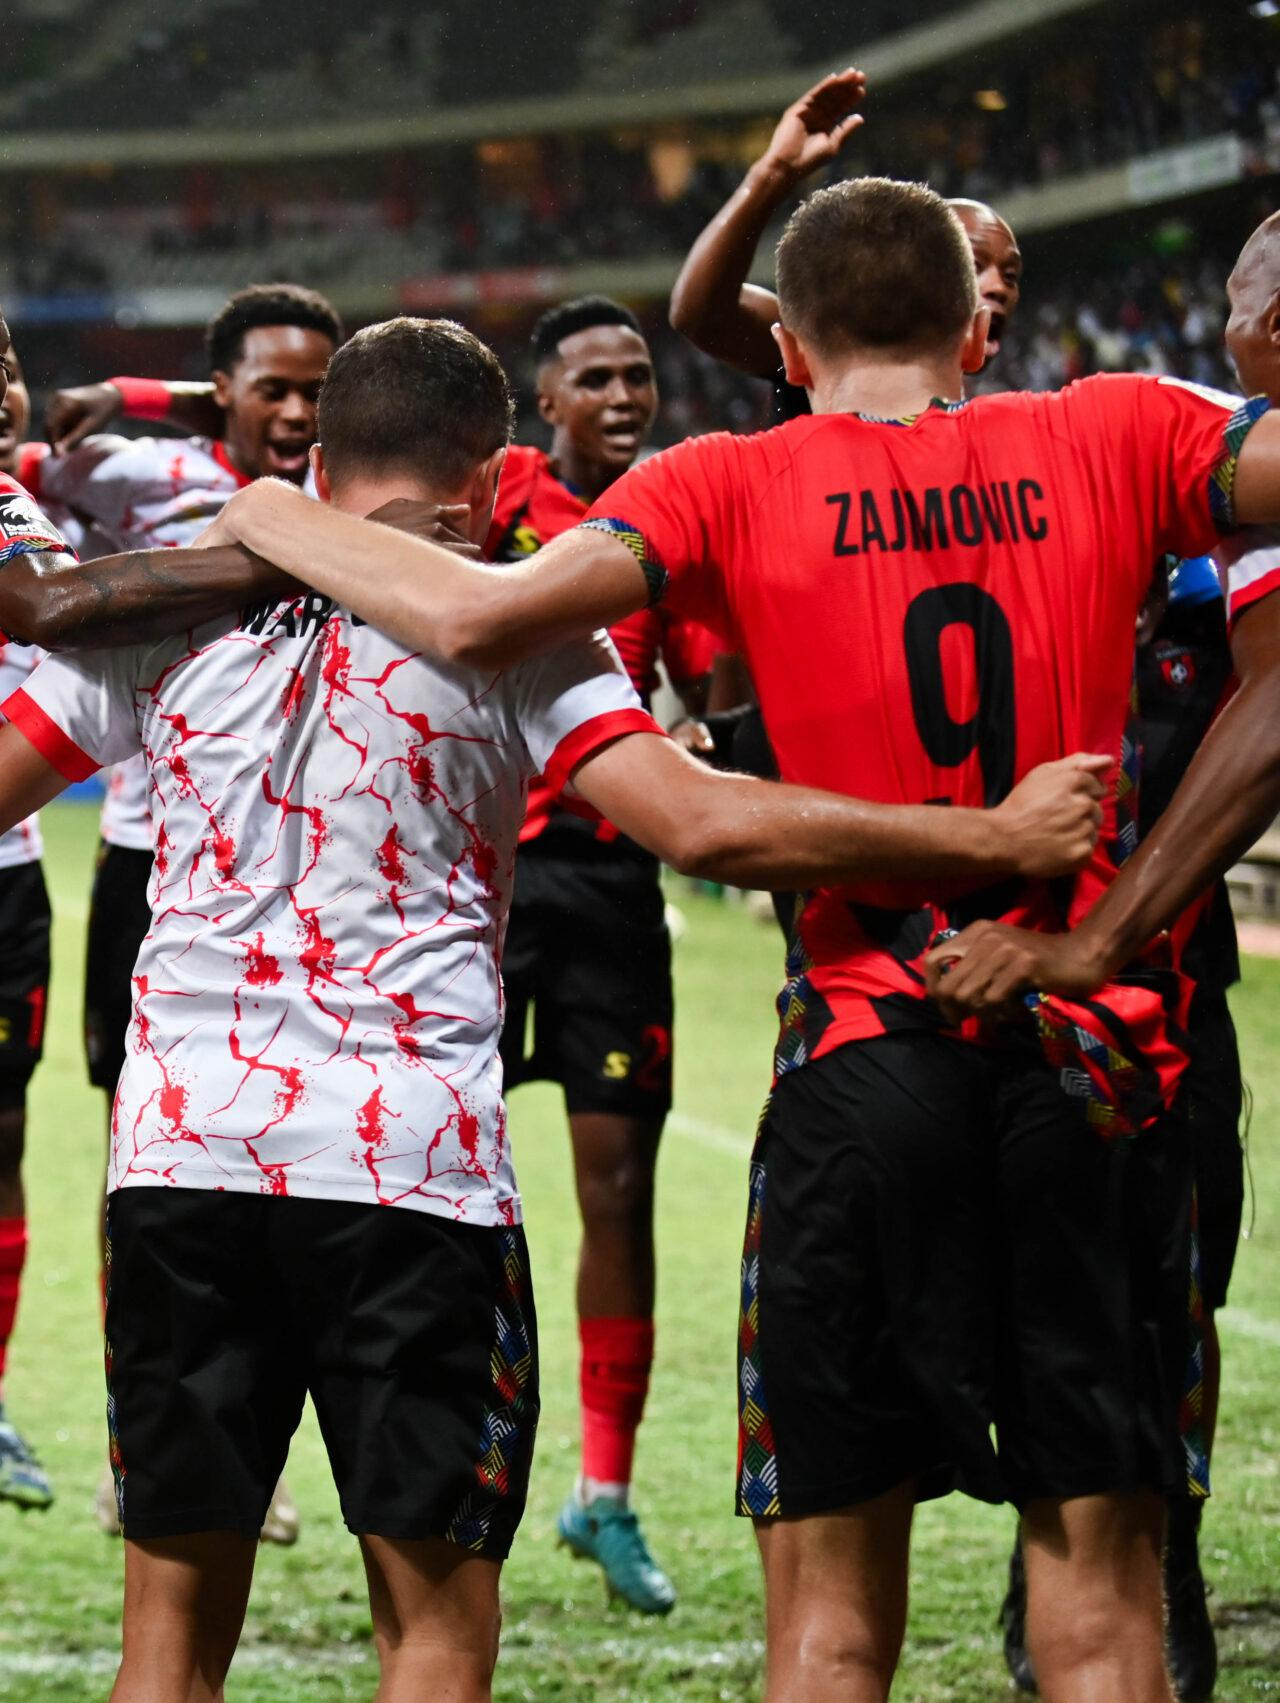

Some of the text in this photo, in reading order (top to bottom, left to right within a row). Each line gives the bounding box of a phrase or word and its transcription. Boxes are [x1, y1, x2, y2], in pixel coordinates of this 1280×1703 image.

[825, 478, 1049, 557] ZAJMOVIC
[237, 590, 368, 639] WAR
[903, 581, 1017, 809] 9
